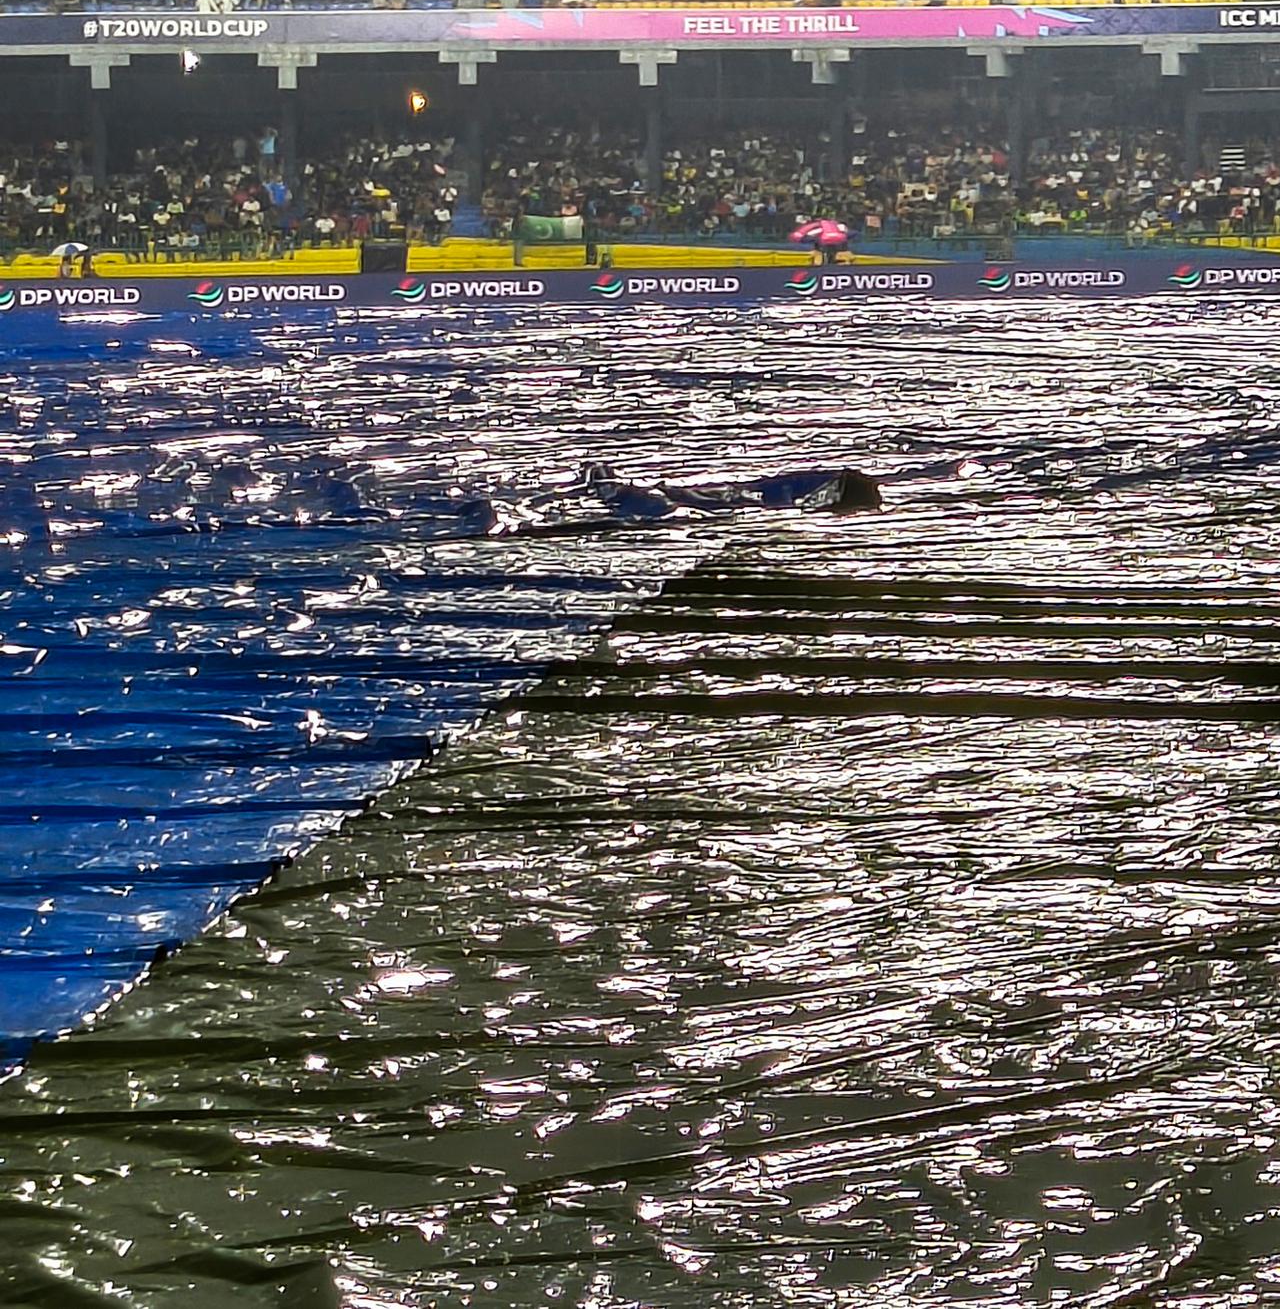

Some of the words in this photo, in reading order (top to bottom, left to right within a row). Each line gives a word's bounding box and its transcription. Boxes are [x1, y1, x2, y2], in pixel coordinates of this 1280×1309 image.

[683, 17, 736, 35] FEEL
[740, 17, 780, 34] THE
[786, 15, 859, 33] THRILL
[1220, 10, 1256, 26] ICC
[84, 19, 267, 38] #T20WORLDCUP
[628, 277, 658, 293] DP
[659, 277, 739, 293] WORLD
[821, 274, 852, 290] DP
[853, 274, 933, 290] WORLD
[1045, 271, 1124, 287] WORLD
[20, 288, 52, 306] DP
[54, 288, 140, 306] WORLD
[228, 285, 259, 302] DP
[261, 285, 345, 302] WORLD
[430, 280, 461, 298] DP
[462, 280, 544, 298] WORLD
